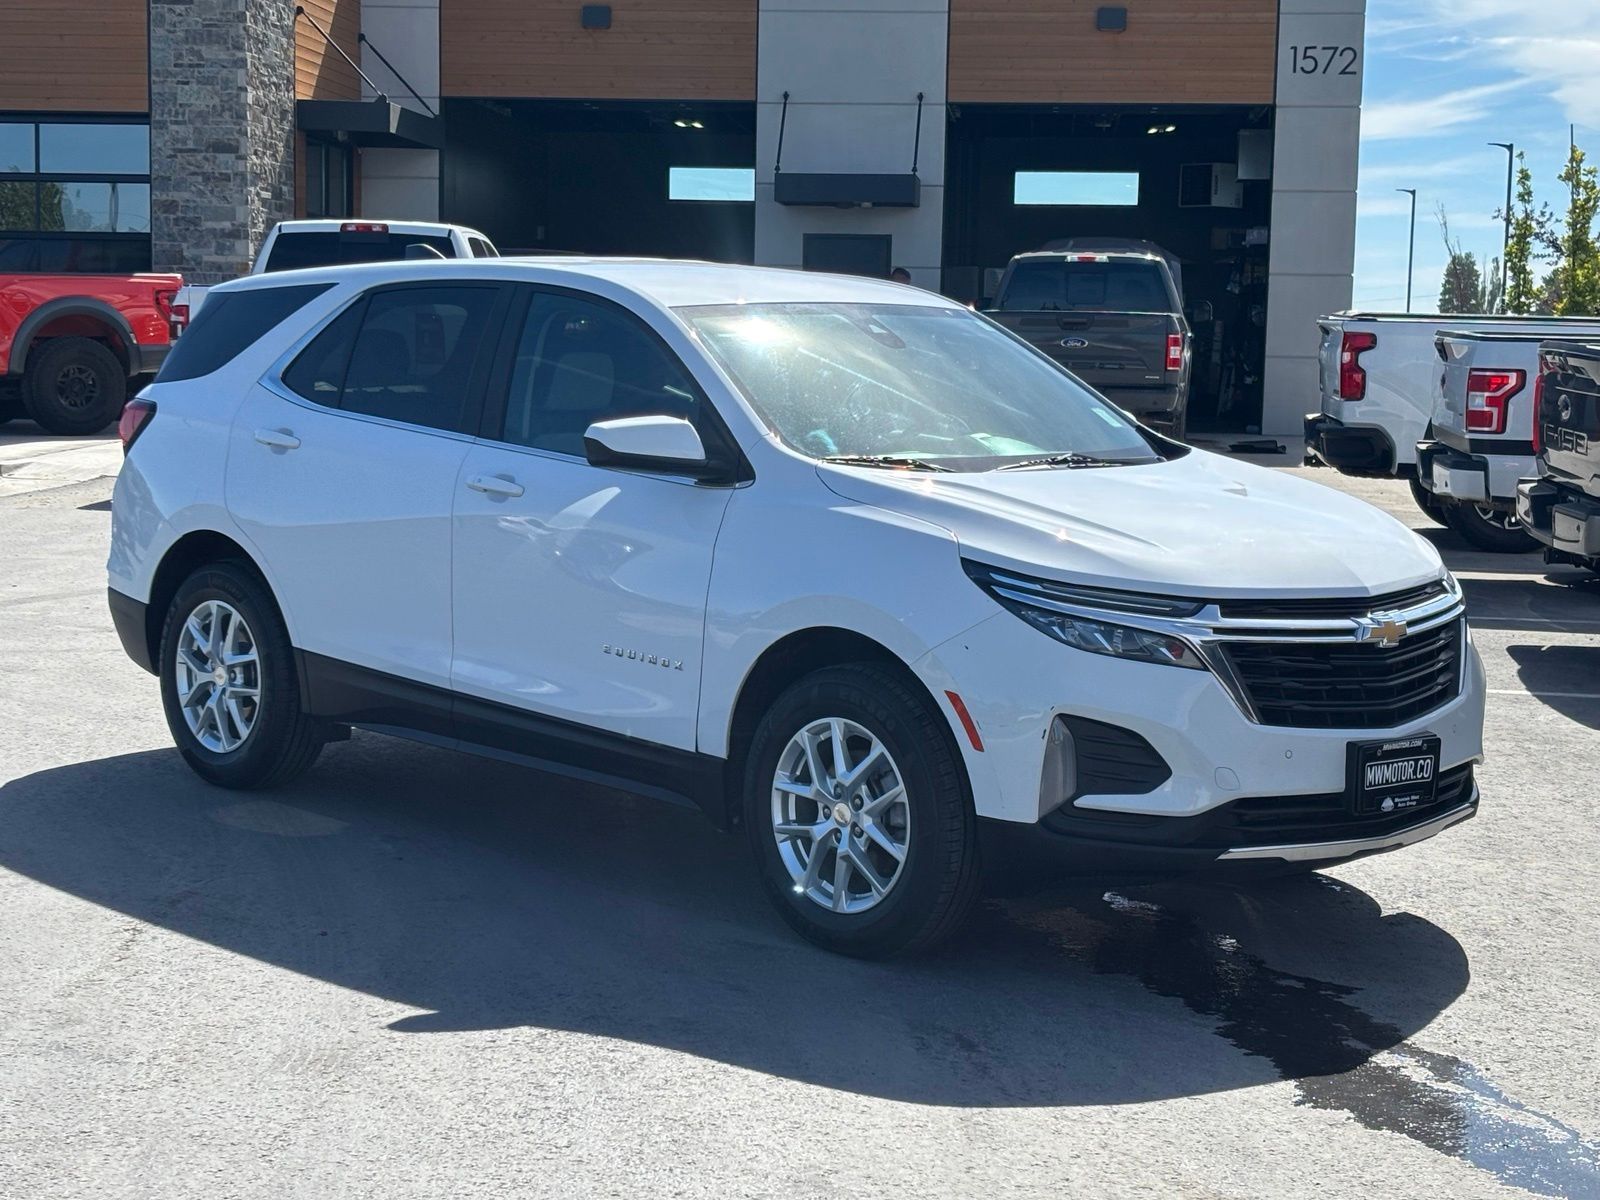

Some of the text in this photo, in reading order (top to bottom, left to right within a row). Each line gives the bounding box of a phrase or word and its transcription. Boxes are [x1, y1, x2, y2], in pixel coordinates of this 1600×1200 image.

[1290, 46, 1357, 75] 1572
[1543, 424, 1588, 456] F-150
[603, 644, 683, 671] EQUINOX
[1366, 759, 1431, 787] MWMOTOR.CO
